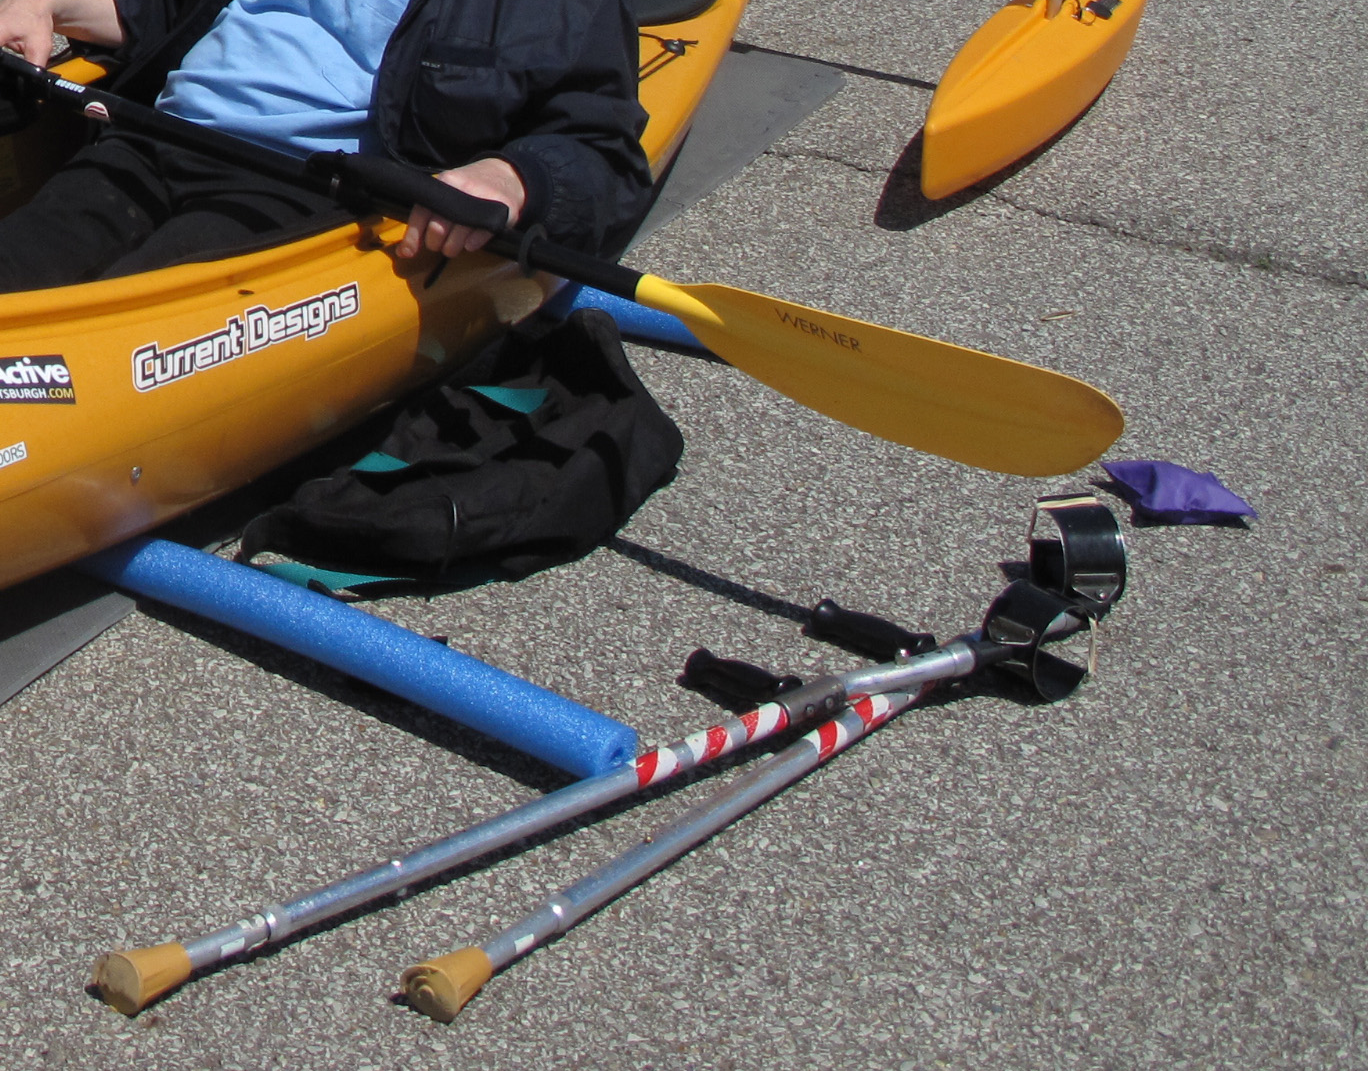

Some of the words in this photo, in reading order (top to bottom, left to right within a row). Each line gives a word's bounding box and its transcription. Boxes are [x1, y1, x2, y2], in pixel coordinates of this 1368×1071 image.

[134, 319, 244, 391] Current
[247, 283, 360, 340] Designs
[774, 308, 863, 353] WERNER
